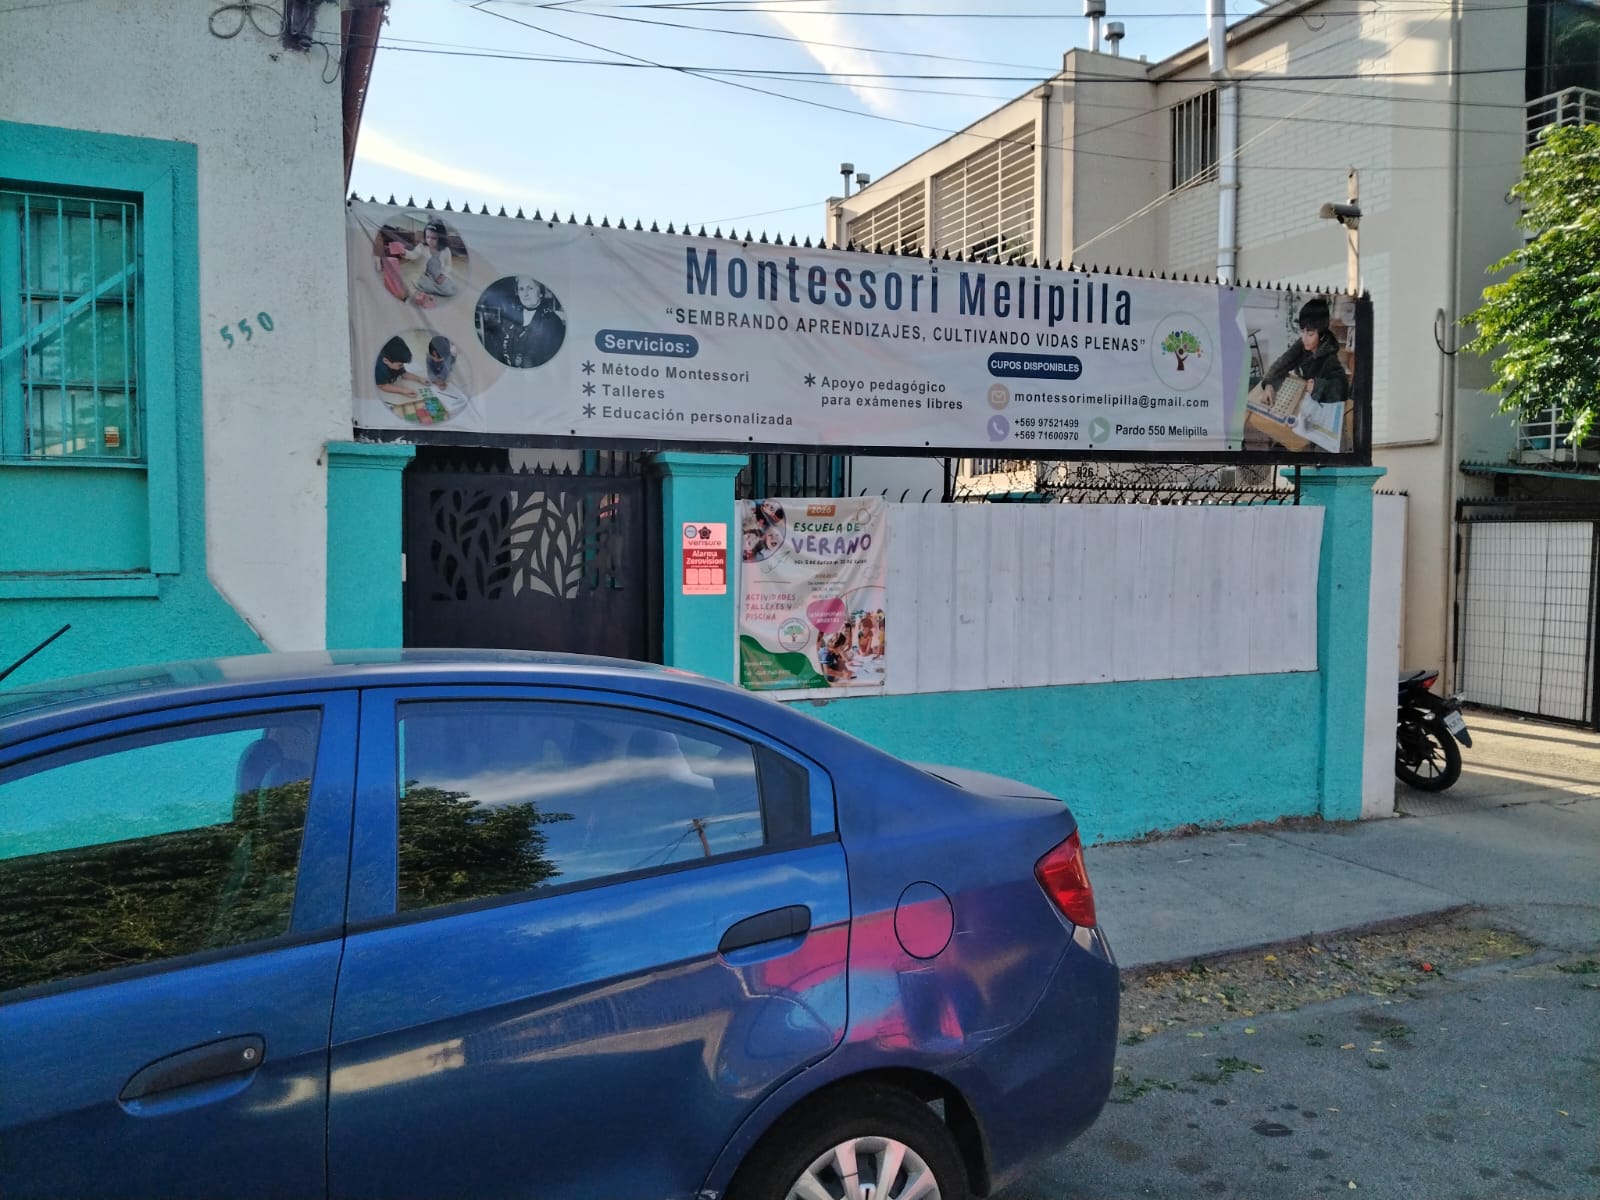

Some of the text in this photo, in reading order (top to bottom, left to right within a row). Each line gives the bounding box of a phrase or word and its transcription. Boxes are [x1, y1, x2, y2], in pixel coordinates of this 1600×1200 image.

[686, 247, 1131, 327] Montessori Melipilla
[220, 311, 274, 349] 550
[796, 317, 926, 342] APRENDIZAJES,
[933, 326, 1030, 346] CULTIVANDO
[1036, 333, 1079, 349] VIDAS
[604, 334, 690, 354] Servicios:
[602, 362, 750, 383] Método Montessori
[990, 359, 1080, 373] CUPOS DISPONIBLES
[602, 383, 665, 399] Talleres
[821, 376, 946, 395] Apoyo pedagógico
[821, 395, 963, 410] para exámenes libres
[1014, 391, 1209, 409] montessorimelipilla@gmail.com
[602, 405, 793, 426] Educación personalizada
[1014, 418, 1079, 428] +569 97521499
[1014, 430, 1079, 441] +569 71600970
[1115, 424, 1208, 438] Pardo 550 Melipilla
[793, 522, 861, 533] ESCUELA DE
[791, 533, 872, 555] VERANO
[745, 593, 796, 601] ACTIVIDADES
[745, 602, 785, 610] TALLERES
